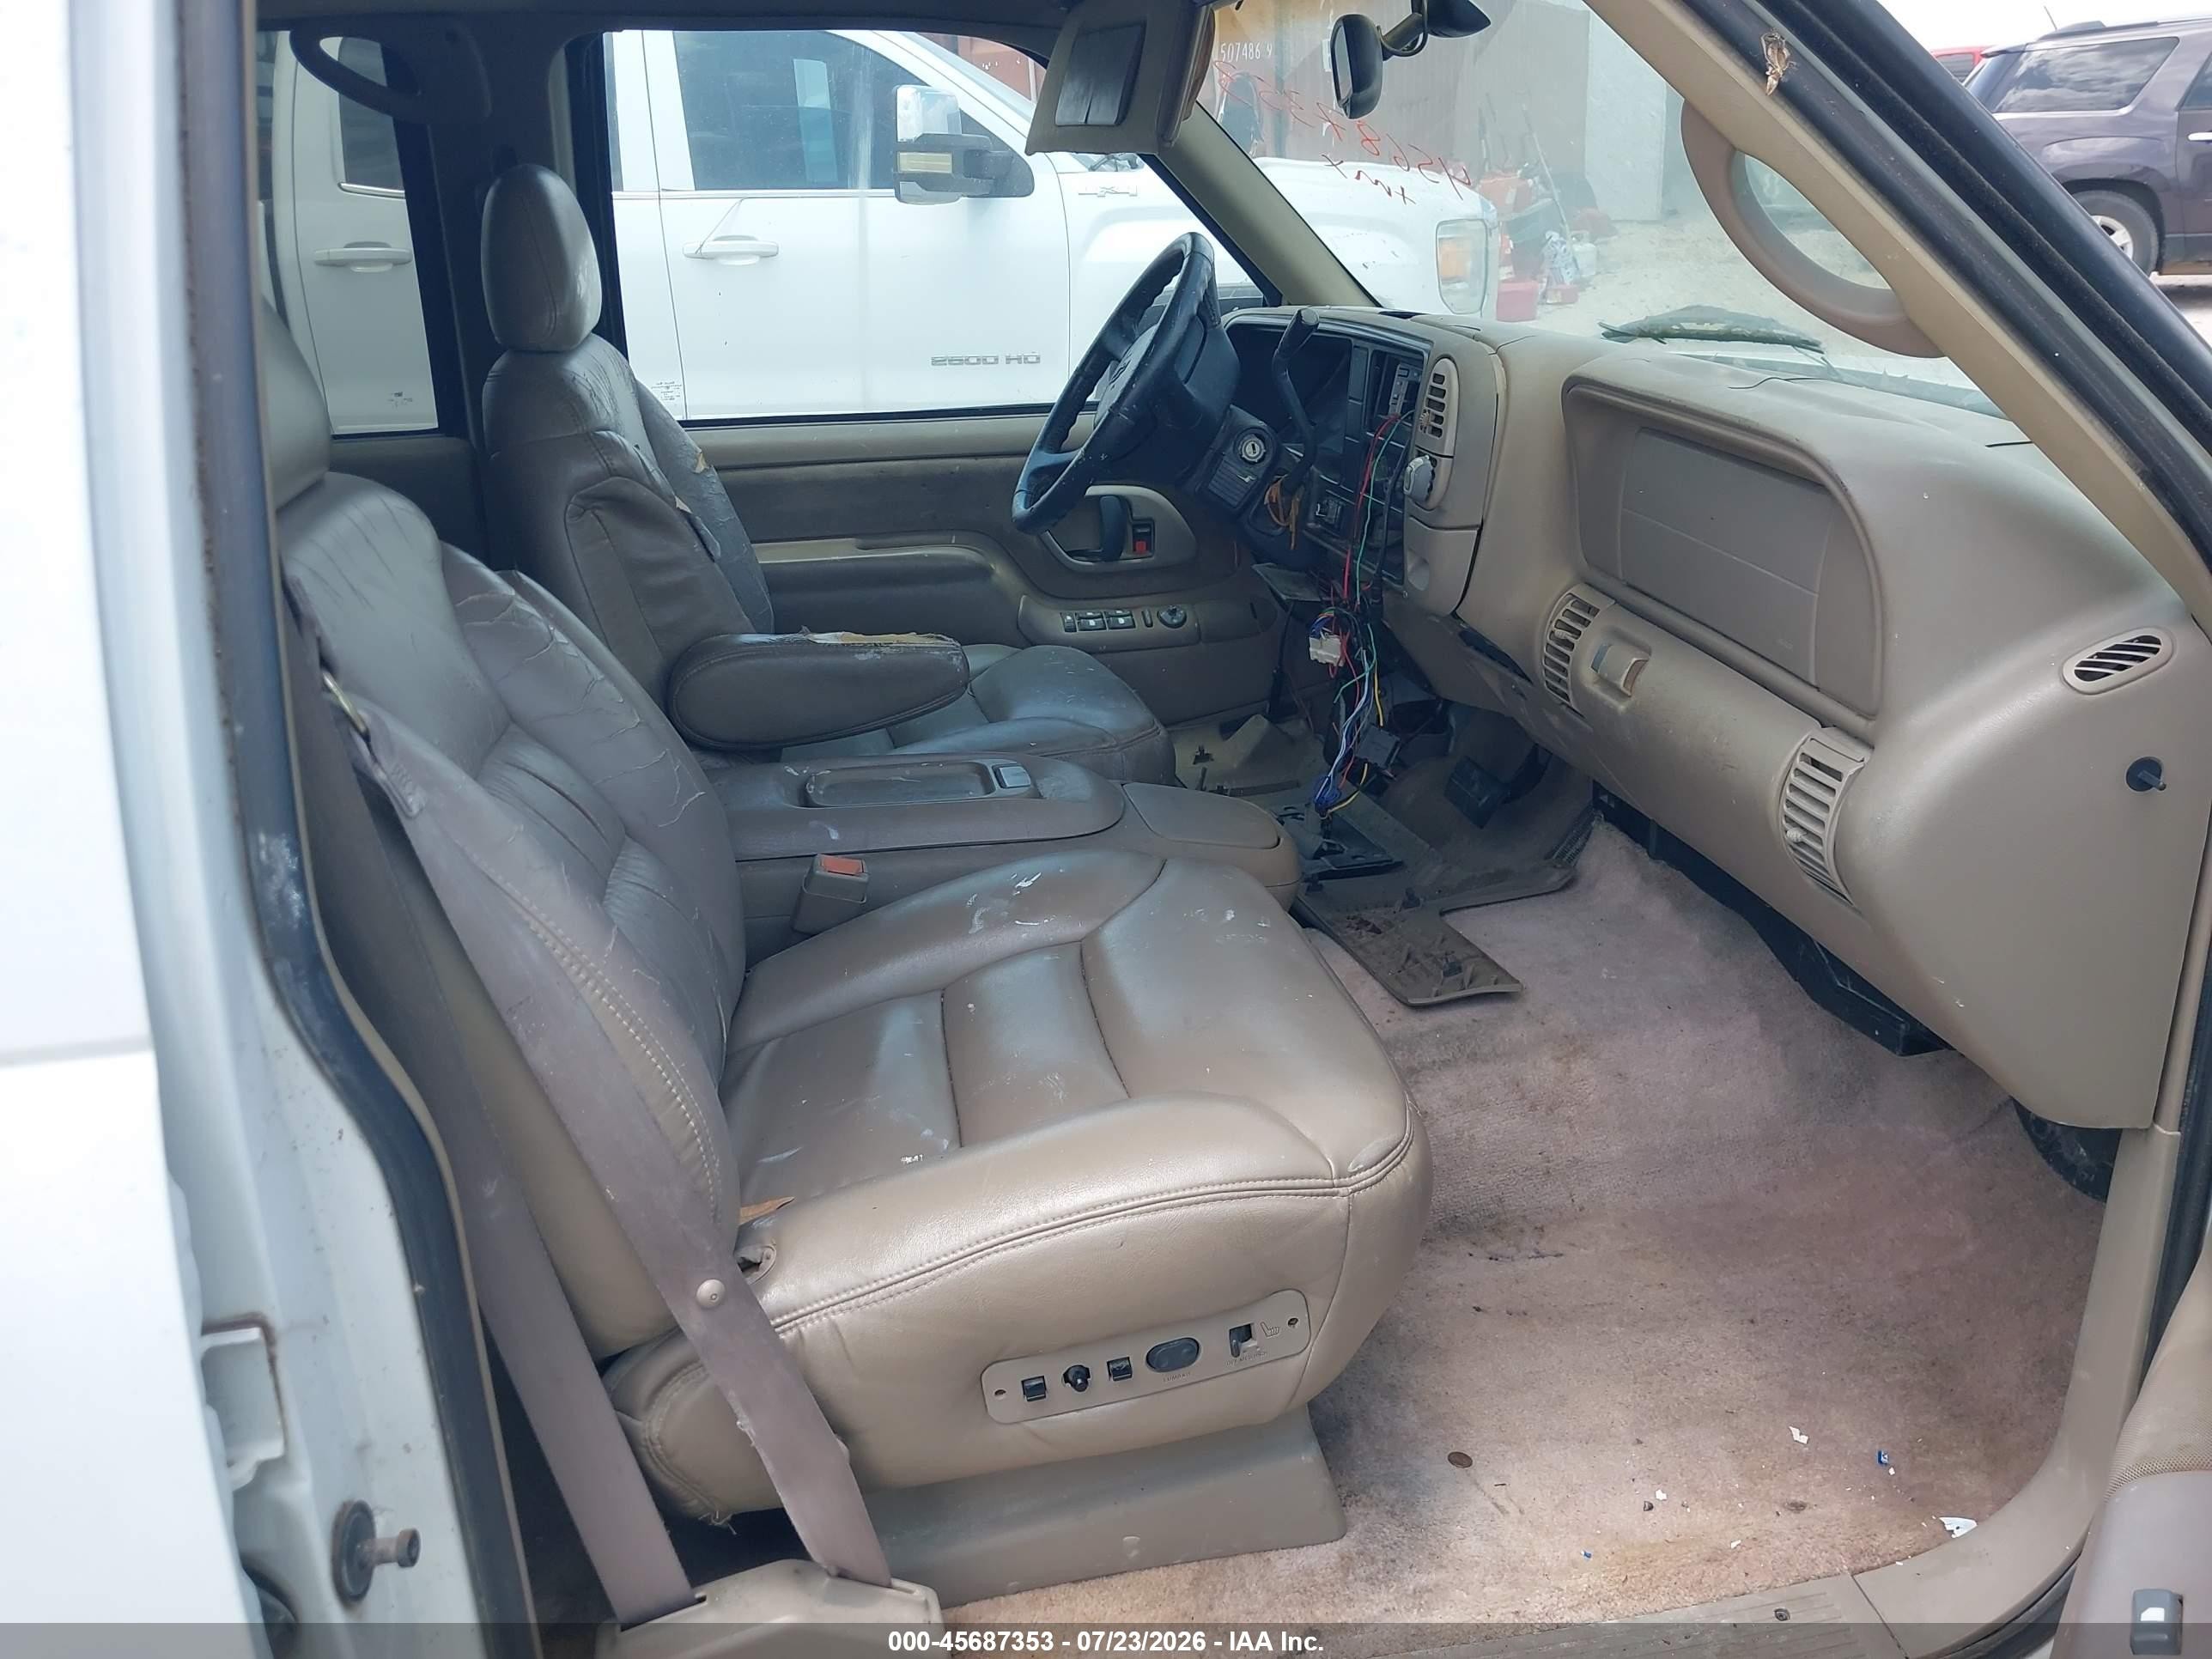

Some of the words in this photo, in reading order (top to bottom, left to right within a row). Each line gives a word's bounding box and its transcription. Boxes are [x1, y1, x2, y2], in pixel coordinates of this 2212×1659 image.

[1220, 41, 1261, 63] 507486
[931, 355, 1000, 367] 2500
[1005, 353, 1042, 365] HD
